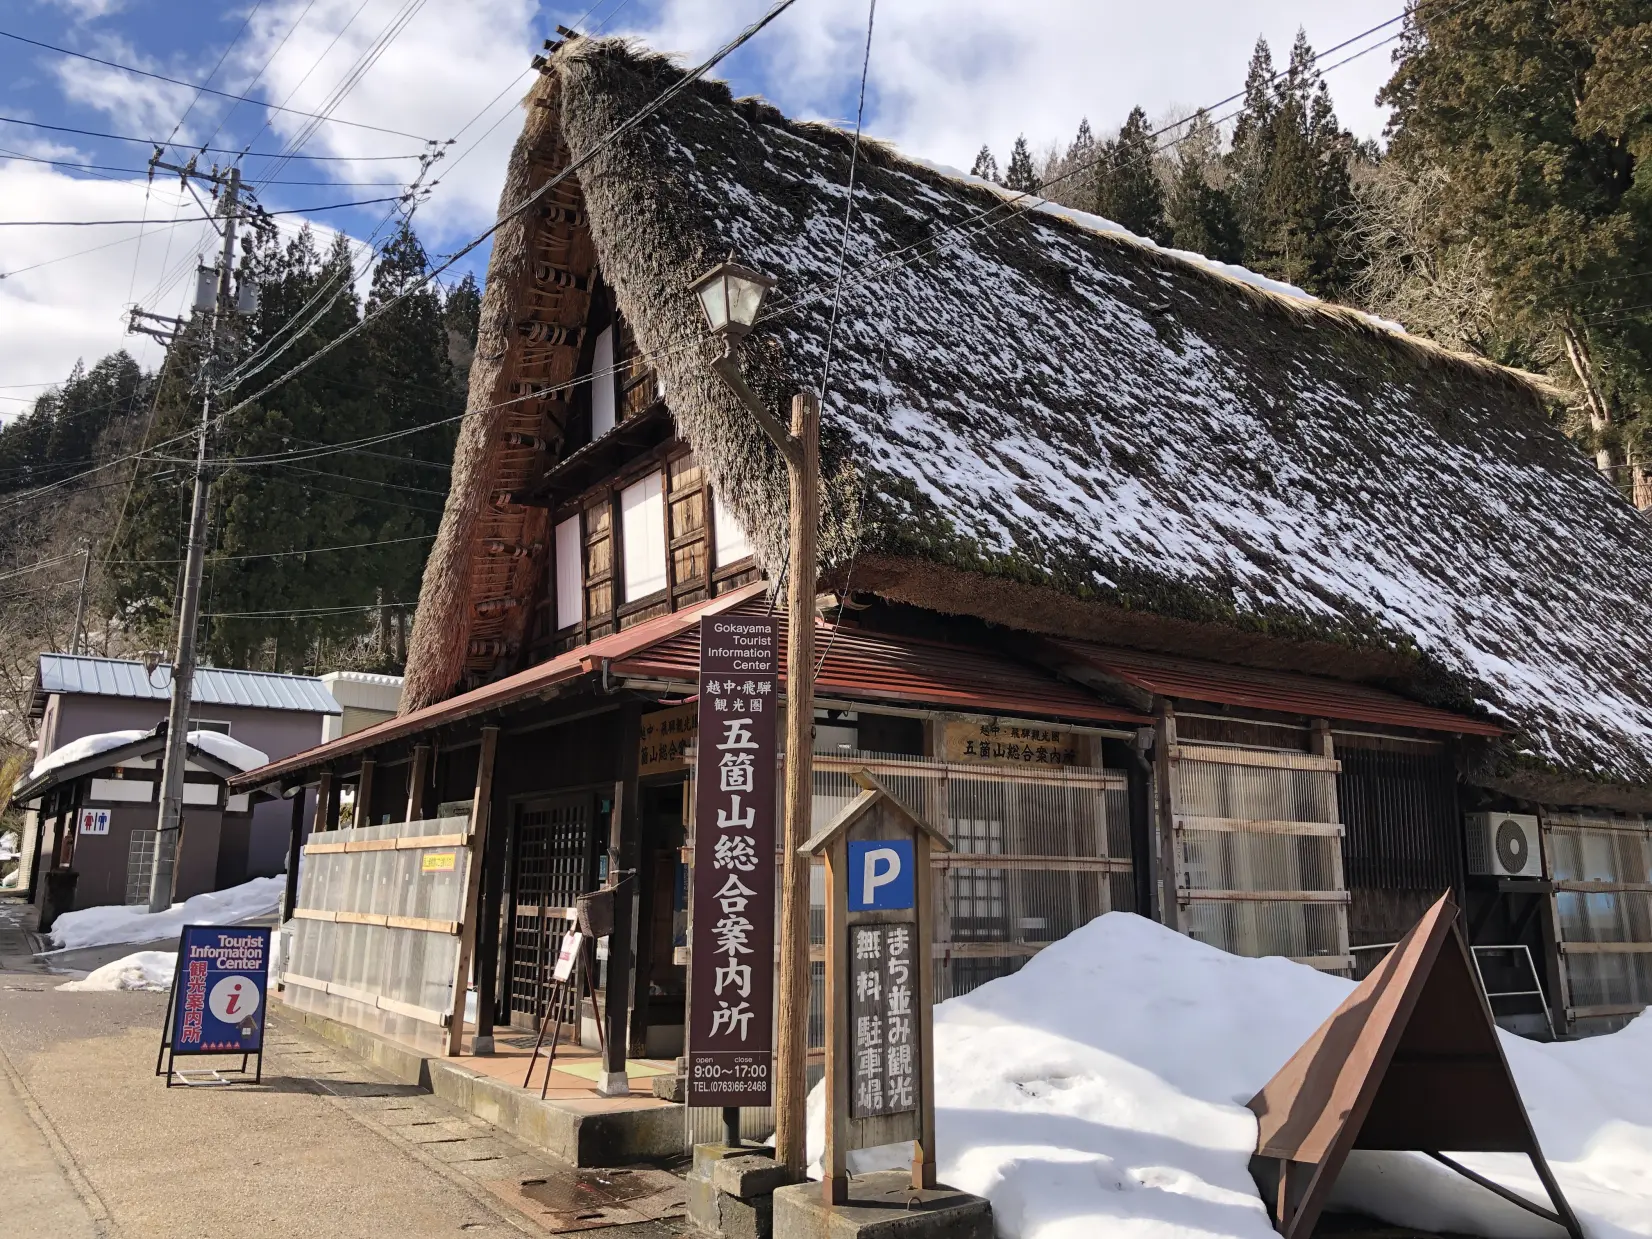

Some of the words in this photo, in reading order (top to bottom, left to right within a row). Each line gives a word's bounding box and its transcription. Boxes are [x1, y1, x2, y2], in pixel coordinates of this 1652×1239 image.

[714, 623, 772, 634] Gokayama
[733, 636, 772, 646] Tourist
[708, 648, 771, 658] Information
[733, 660, 771, 670] Center
[709, 718, 760, 1042] 五箇山総合案内所
[862, 848, 901, 905] P
[218, 935, 264, 948] Tourist
[190, 945, 262, 958] Information
[216, 957, 262, 969] Center
[181, 960, 208, 1044] 観光案内所
[887, 928, 913, 1108] まち並み観光
[693, 1081, 767, 1093] TEL.(0763)66-2468
